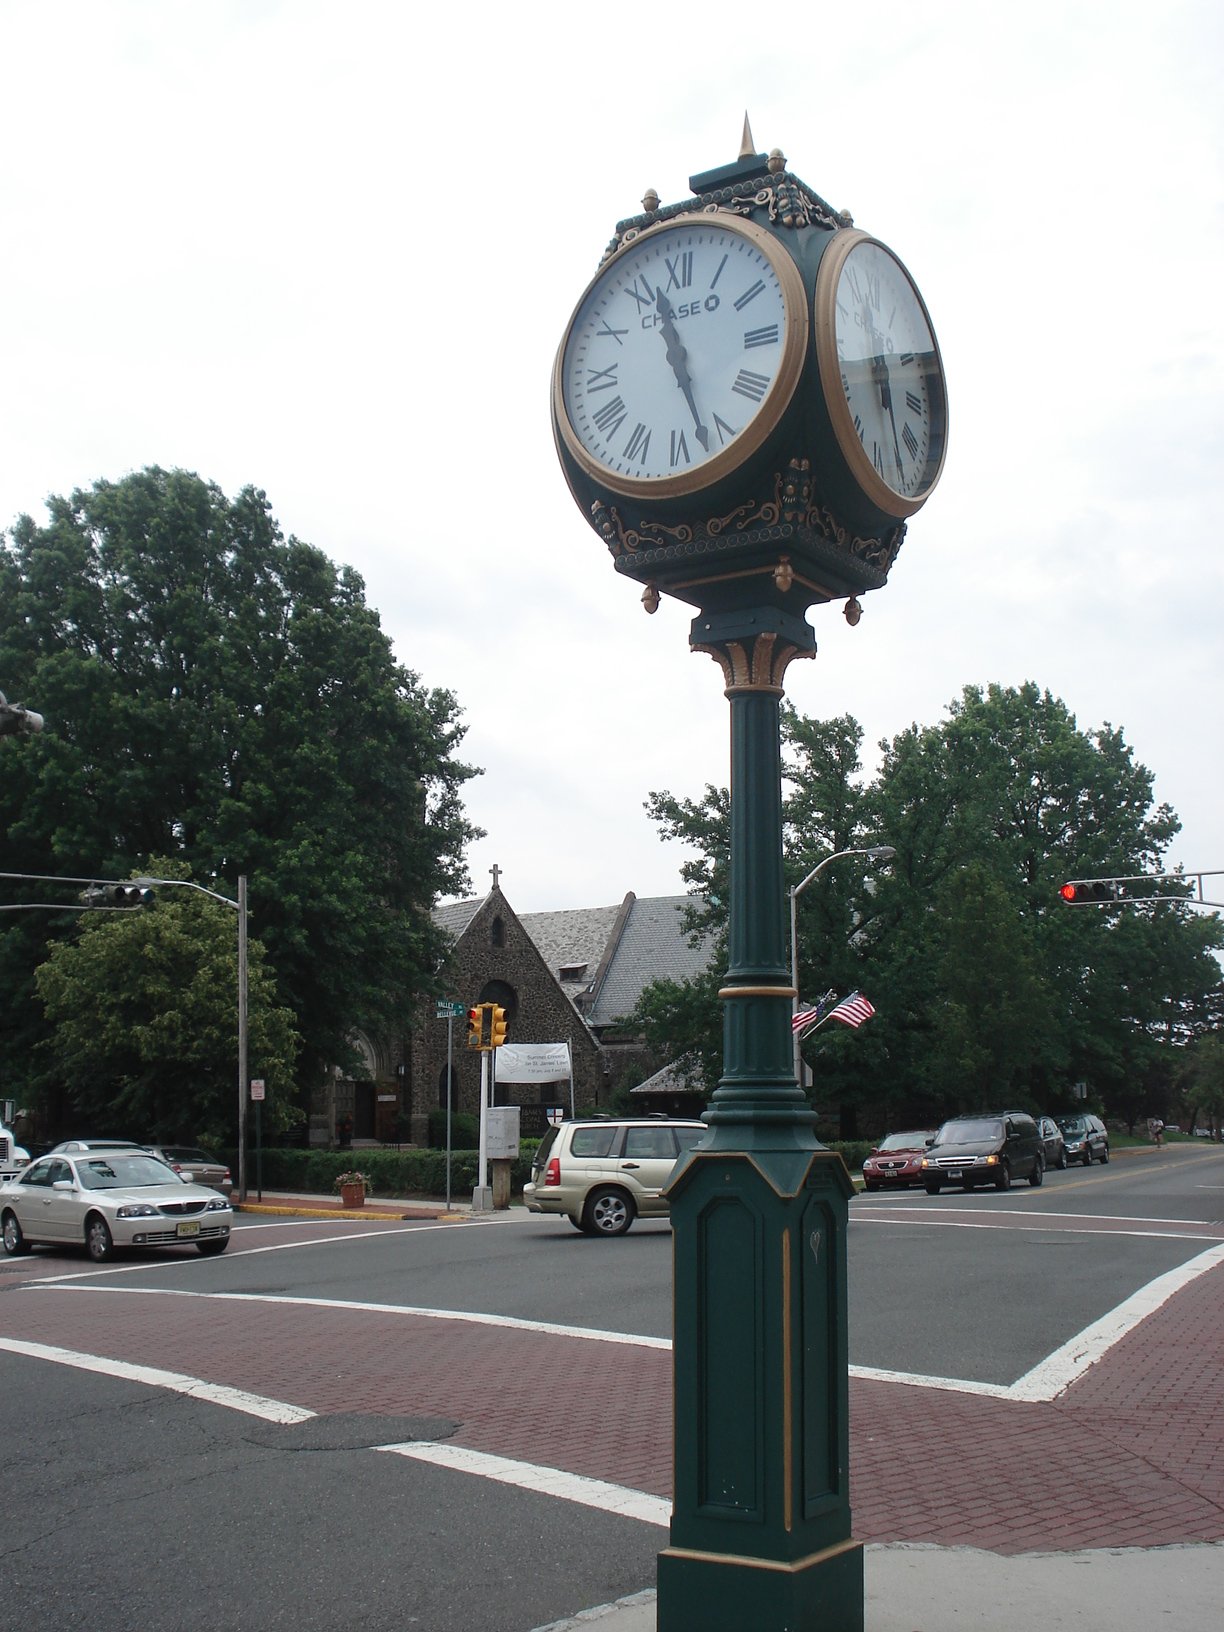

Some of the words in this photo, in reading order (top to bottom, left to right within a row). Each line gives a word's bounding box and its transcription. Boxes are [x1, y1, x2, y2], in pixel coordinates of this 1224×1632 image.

[665, 251, 694, 293] XII
[623, 273, 656, 315] XI
[733, 279, 766, 312] II
[641, 300, 702, 330] CHASE
[596, 320, 629, 346] X
[744, 324, 779, 350] III
[586, 362, 618, 394] IX
[623, 422, 652, 466] VII
[669, 429, 692, 468] VI
